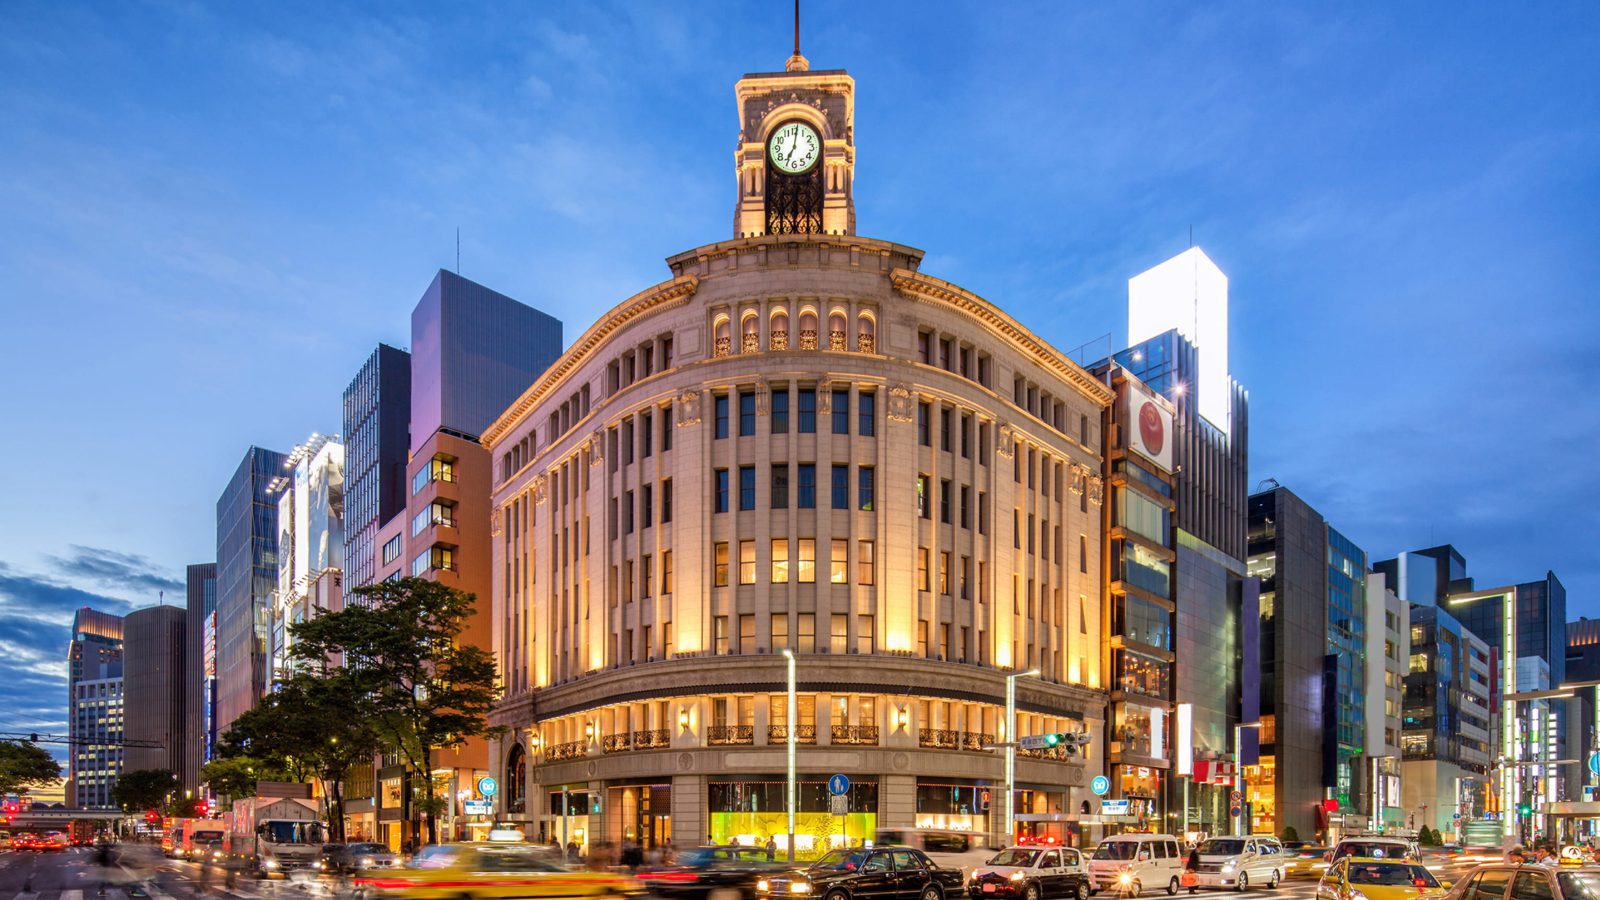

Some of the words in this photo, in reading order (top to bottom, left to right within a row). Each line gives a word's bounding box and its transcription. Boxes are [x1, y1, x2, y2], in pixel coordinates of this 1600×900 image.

[777, 136, 784, 144] 10
[806, 135, 812, 143] 2
[774, 145, 780, 153] 9
[809, 144, 814, 152] 3
[778, 153, 784, 161] 8
[806, 152, 812, 160] 4
[784, 158, 790, 166] 7
[792, 160, 798, 168] 6
[800, 158, 806, 166] 5
